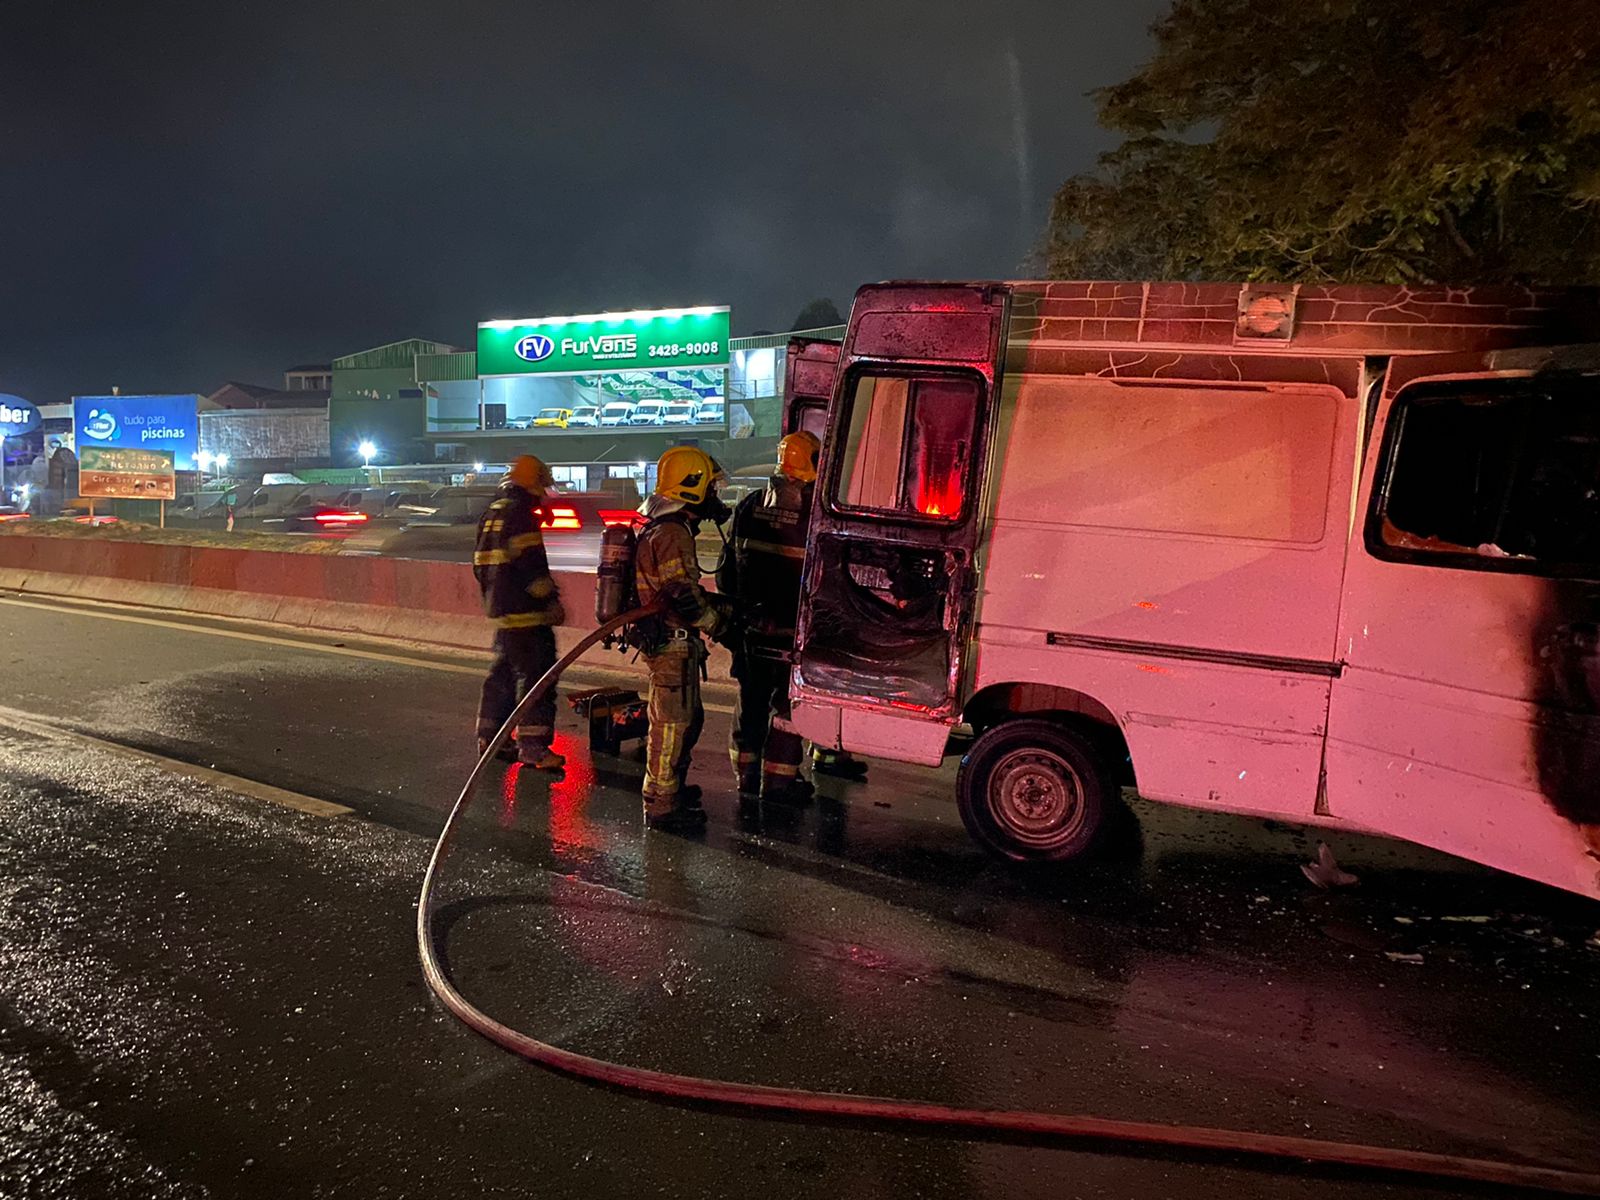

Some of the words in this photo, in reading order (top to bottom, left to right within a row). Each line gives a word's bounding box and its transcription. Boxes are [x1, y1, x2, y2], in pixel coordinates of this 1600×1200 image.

[522, 338, 546, 357] FV
[561, 334, 637, 355] FurVans
[648, 341, 719, 357] 3428-9008
[124, 415, 145, 426] tudo
[147, 415, 166, 427] para
[141, 427, 185, 442] piscinas
